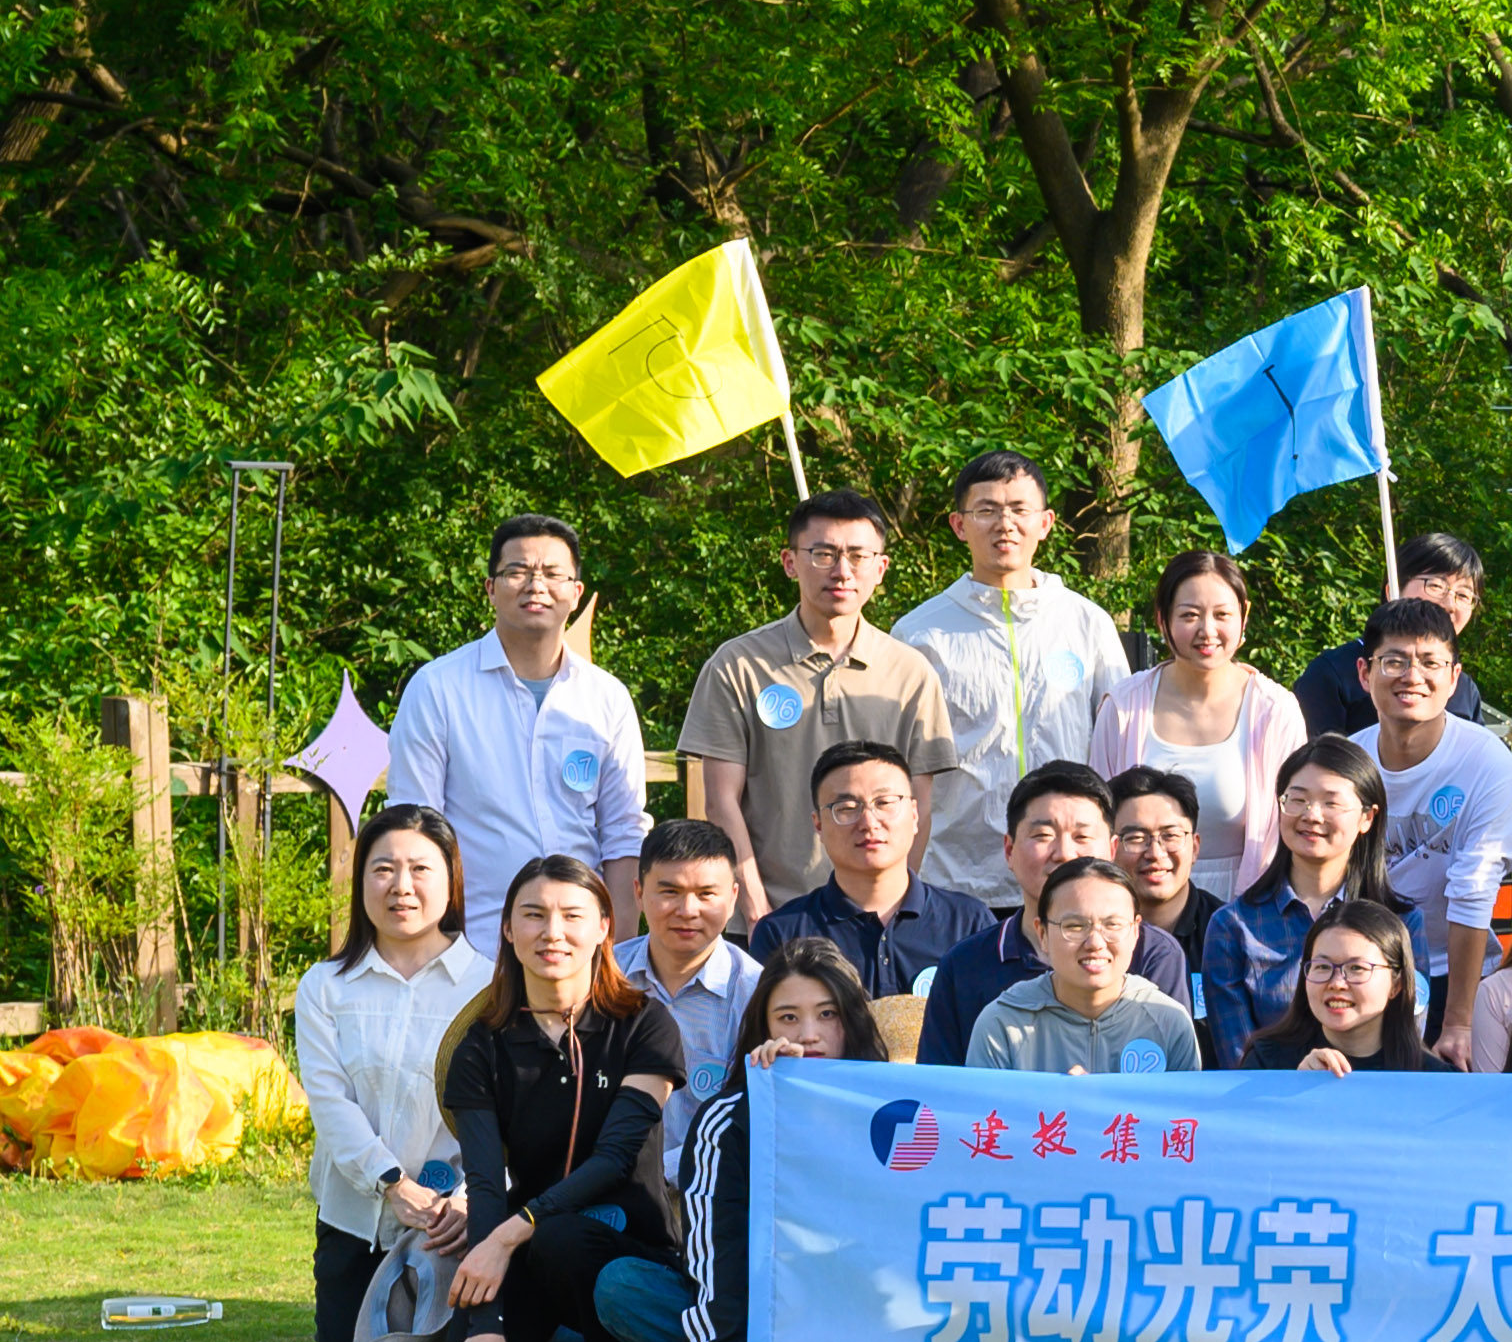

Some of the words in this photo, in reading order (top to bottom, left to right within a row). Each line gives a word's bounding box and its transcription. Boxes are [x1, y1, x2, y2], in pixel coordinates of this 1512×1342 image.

[761, 690, 798, 721] 06
[565, 756, 592, 786] 07
[1433, 794, 1465, 820] 05
[1122, 1050, 1160, 1073] 02
